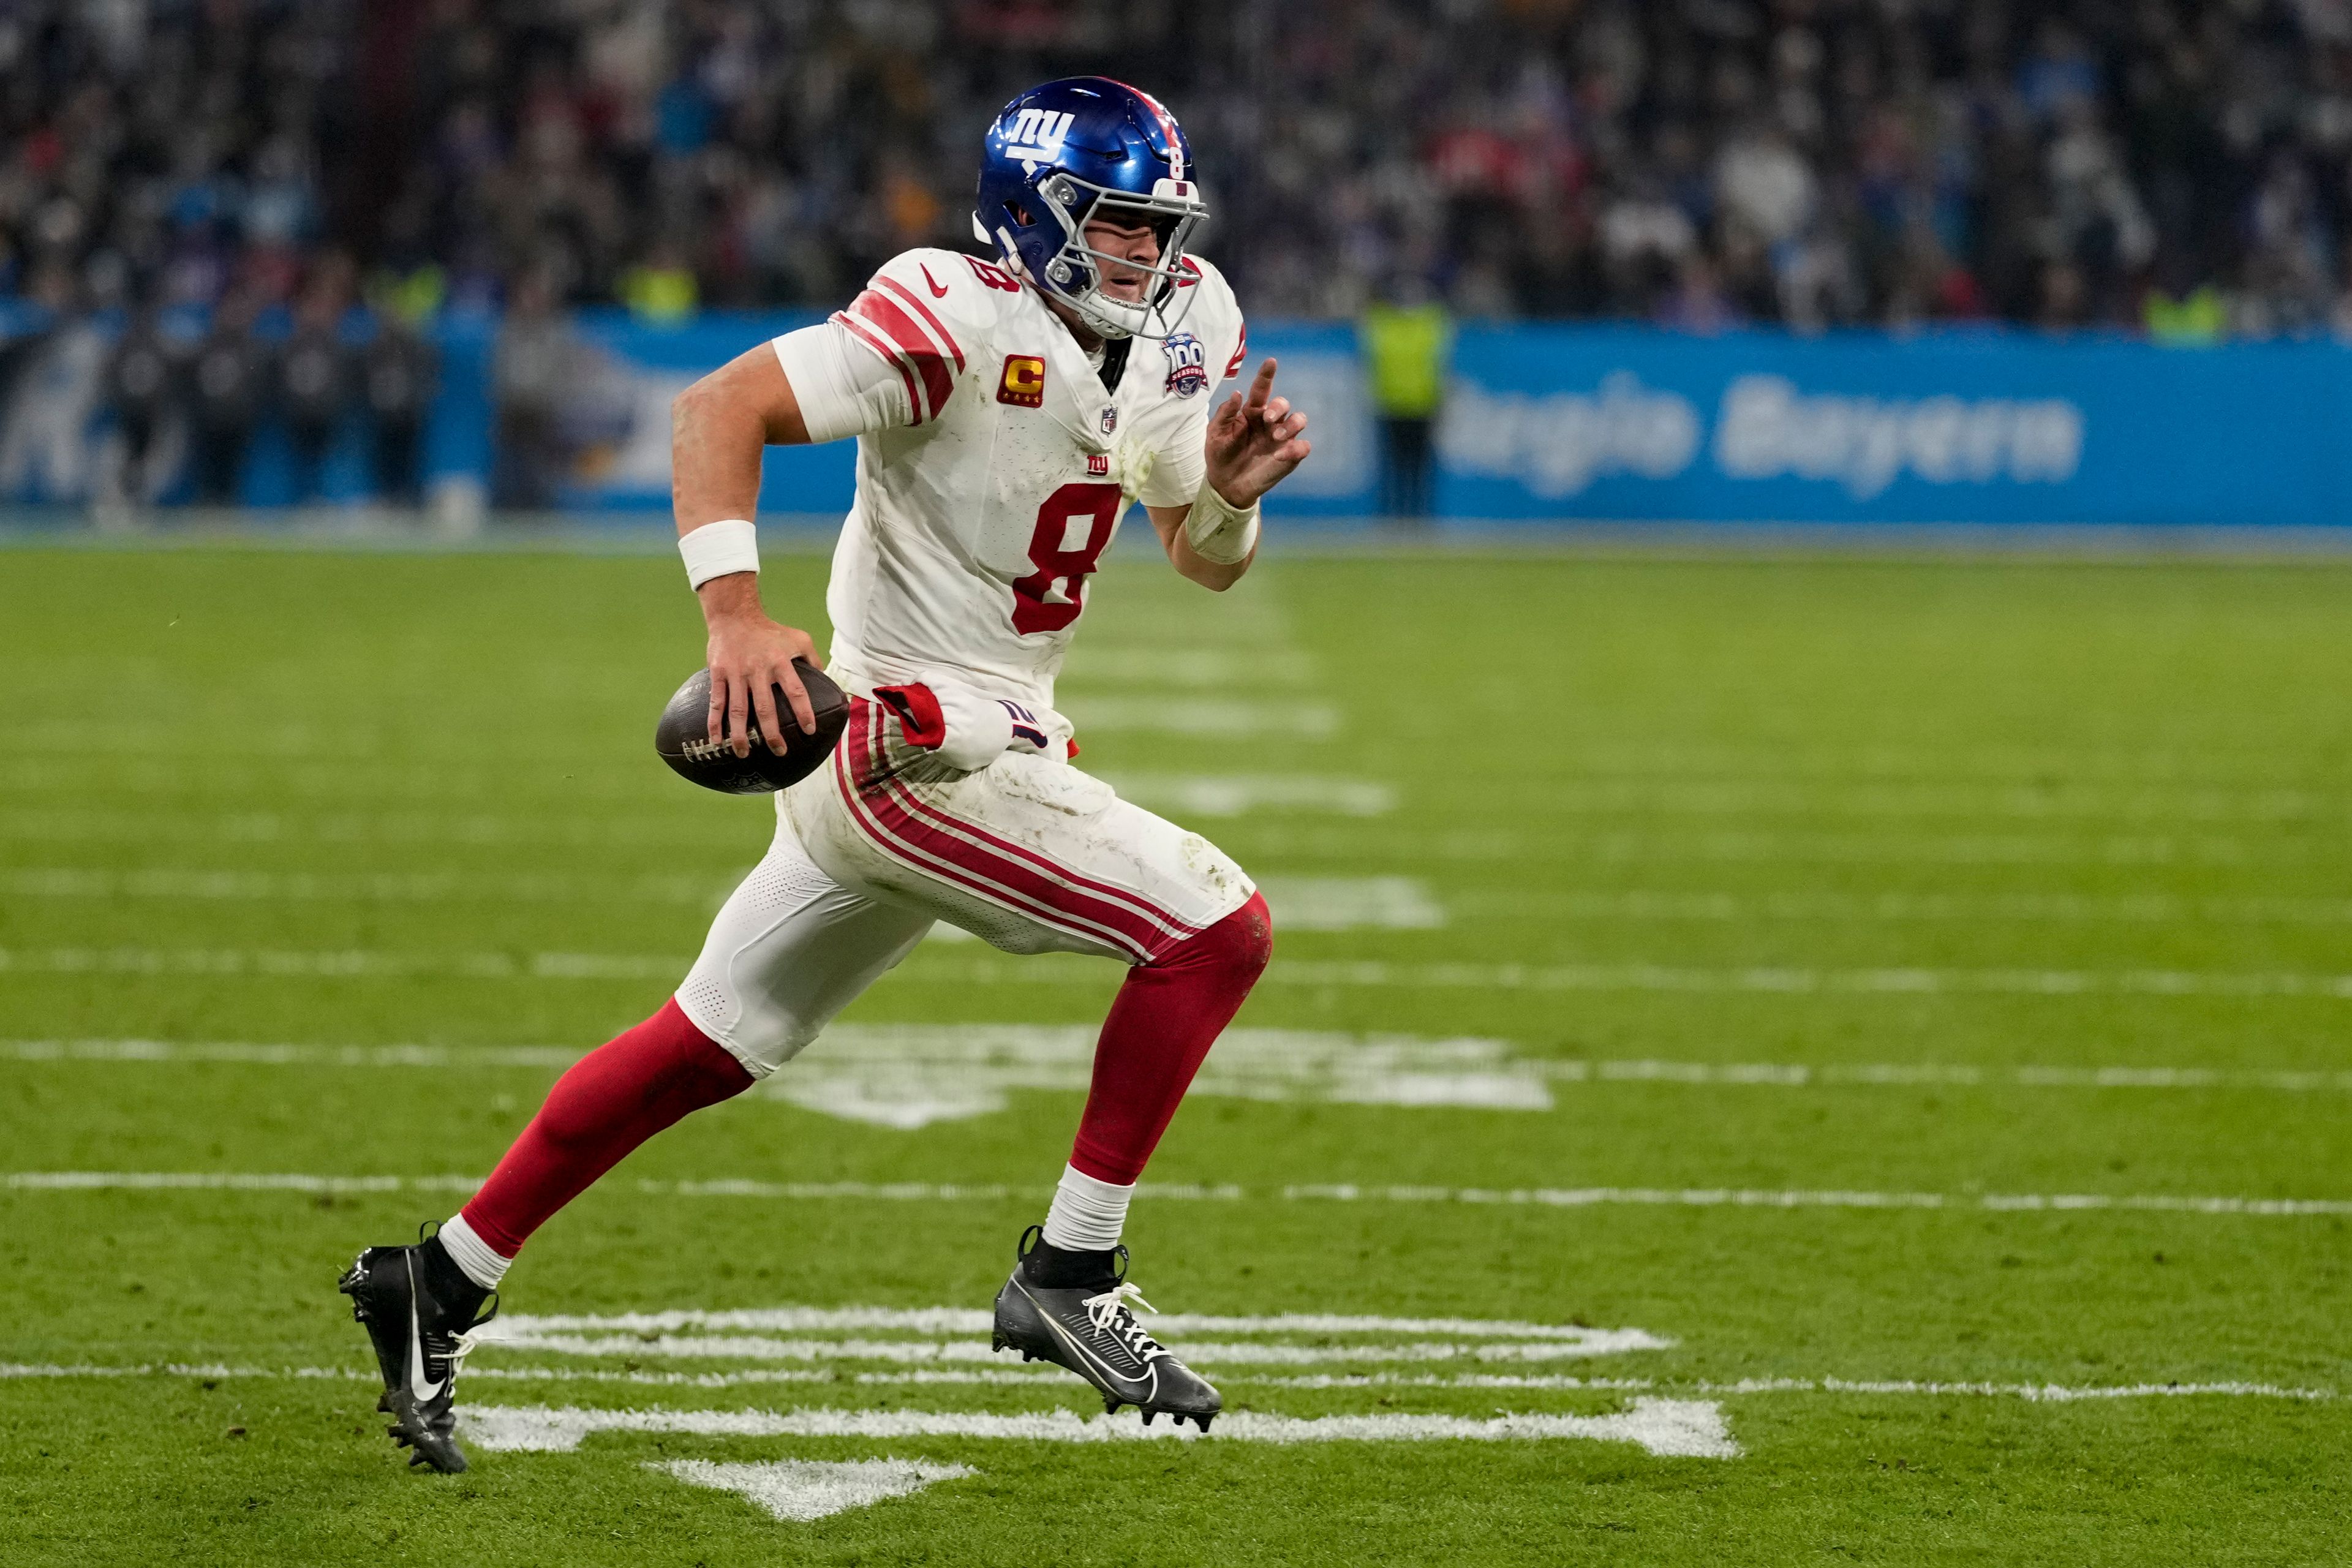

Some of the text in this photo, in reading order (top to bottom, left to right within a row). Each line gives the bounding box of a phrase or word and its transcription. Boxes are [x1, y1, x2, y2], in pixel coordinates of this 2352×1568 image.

[1169, 146, 1185, 180] 8
[1163, 341, 1205, 375] 100
[1171, 368, 1204, 381] SEASONS
[1005, 359, 1044, 394] C
[1011, 483, 1124, 636] 8
